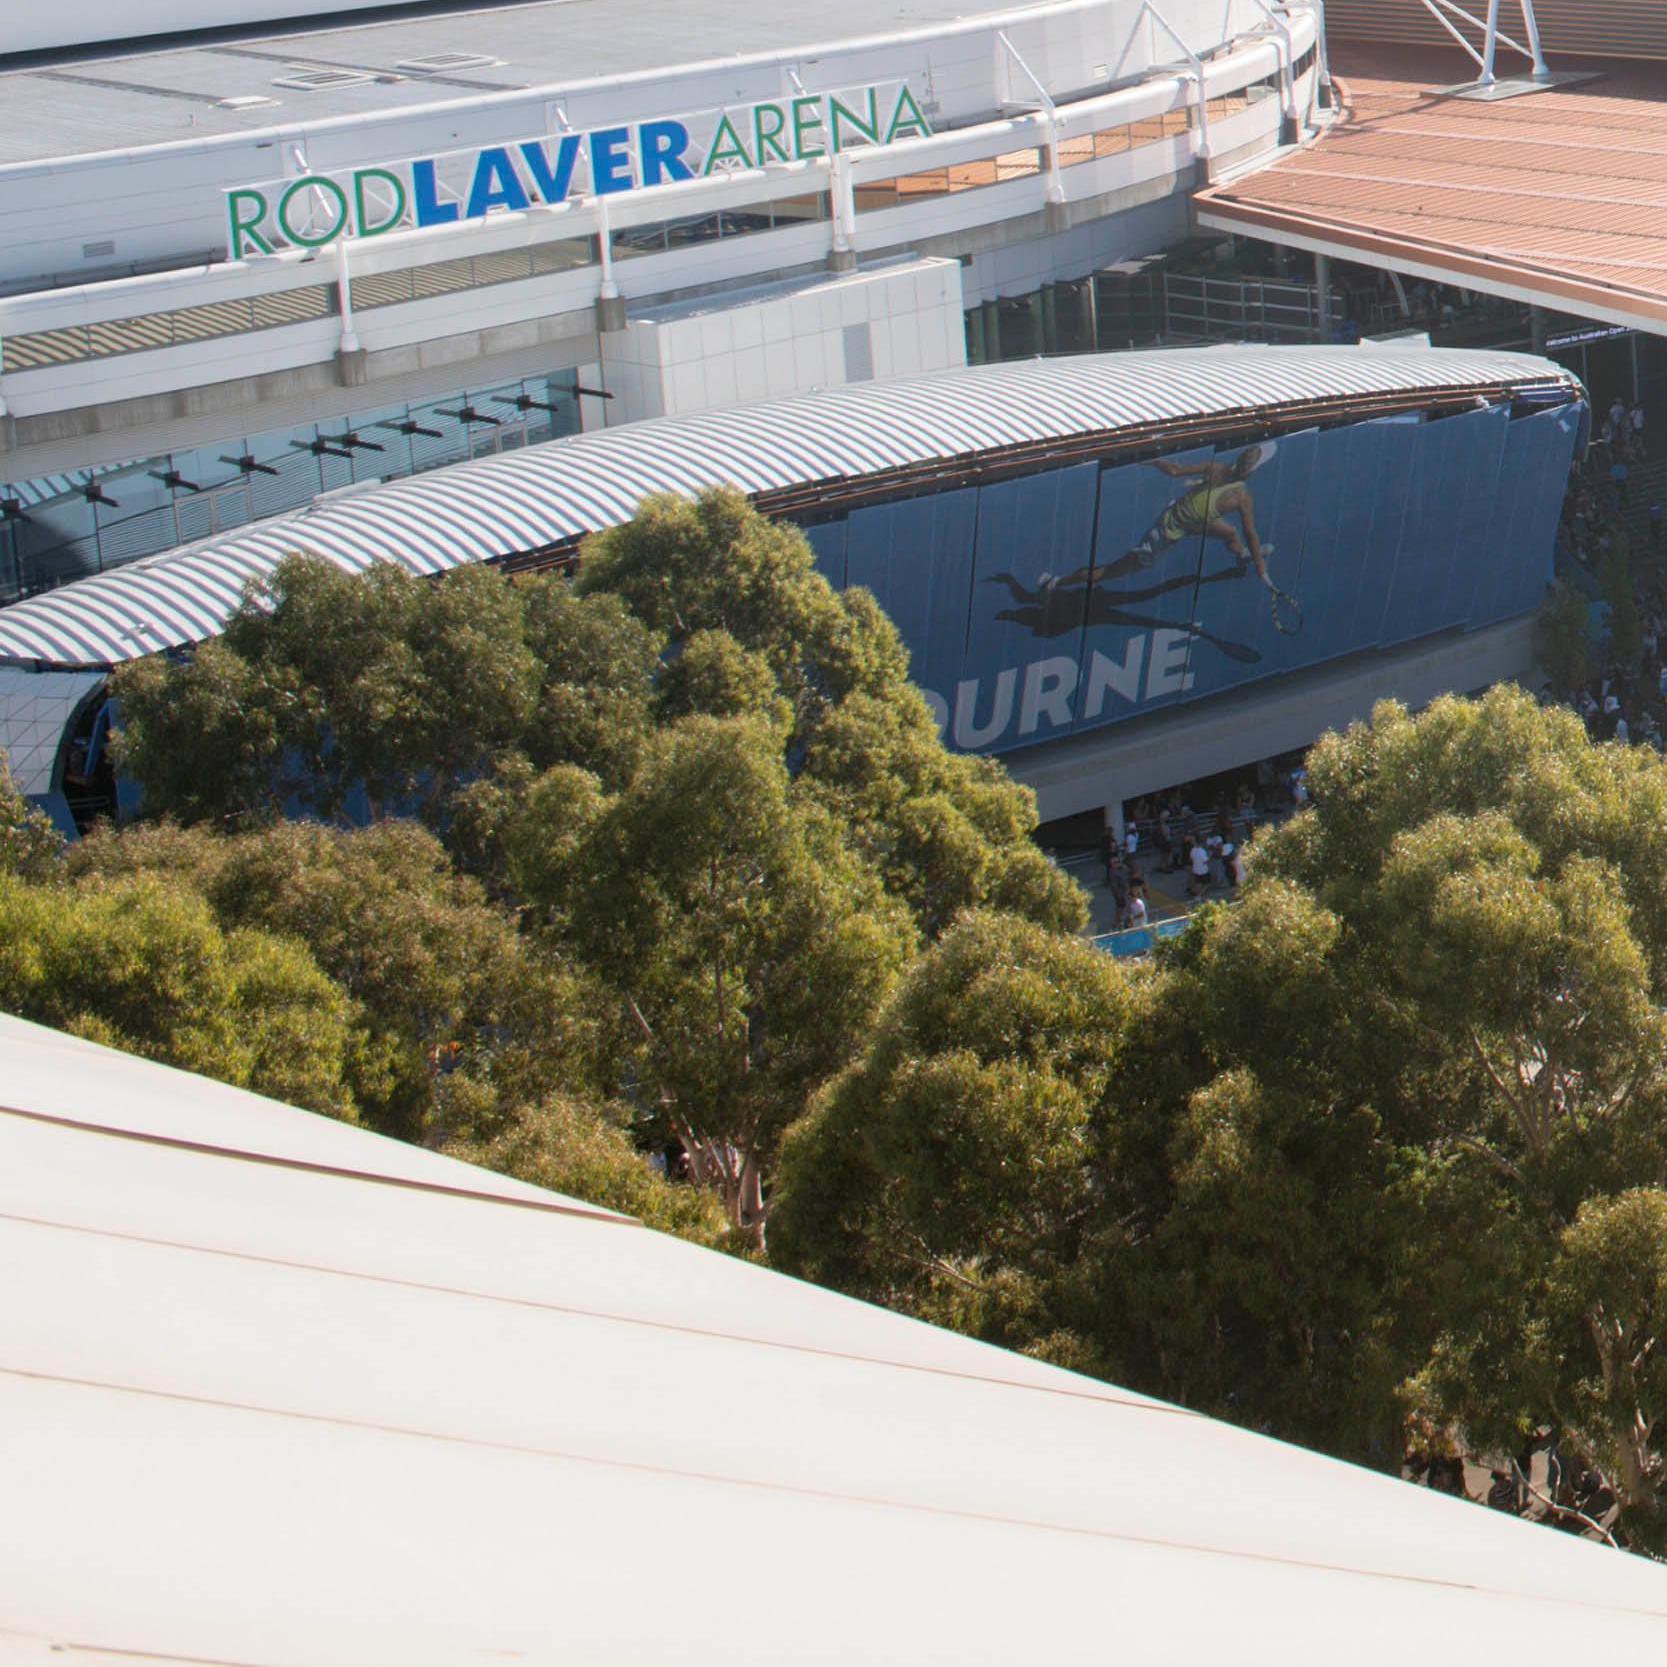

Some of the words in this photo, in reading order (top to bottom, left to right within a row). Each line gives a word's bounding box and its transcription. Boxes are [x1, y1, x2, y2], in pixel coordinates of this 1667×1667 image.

[227, 167, 406, 261] ROD
[412, 119, 695, 227] LAVER
[704, 85, 934, 176] ARENA
